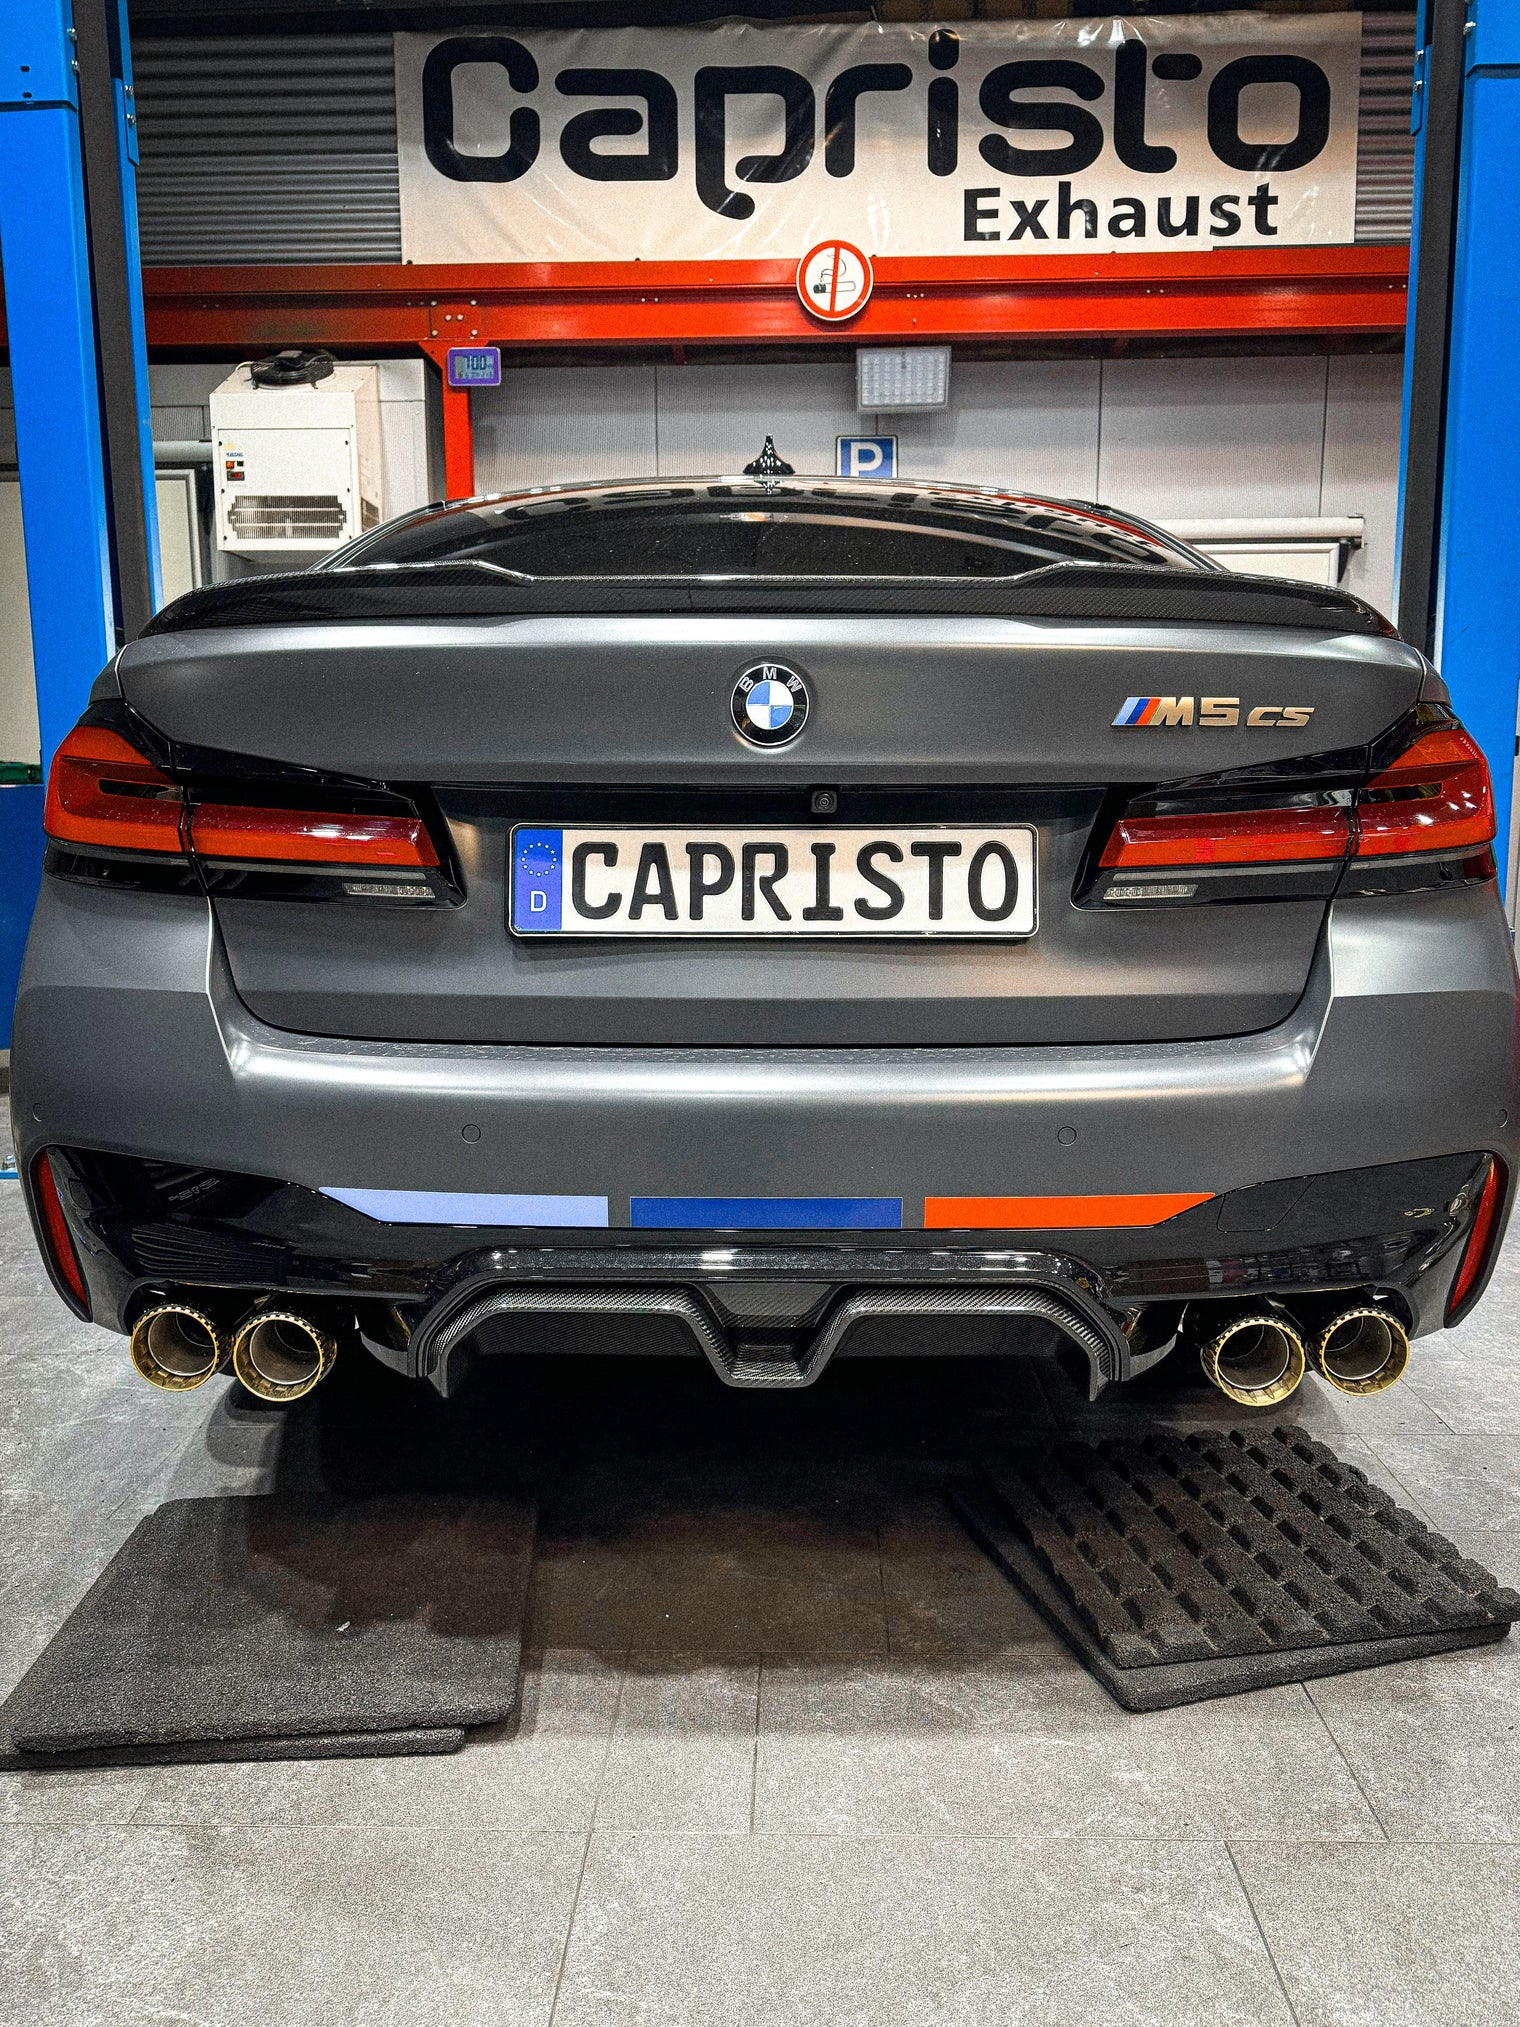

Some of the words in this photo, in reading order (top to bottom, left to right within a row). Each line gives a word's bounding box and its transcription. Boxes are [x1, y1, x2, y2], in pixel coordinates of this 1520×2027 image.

[422, 28, 1332, 221] Capristo
[963, 181, 1279, 242] Exhaust
[850, 442, 883, 477] P
[738, 665, 803, 693] BMW
[1149, 696, 1240, 727] M5
[1246, 706, 1316, 727] CS
[530, 890, 547, 912] D
[571, 840, 1019, 922] CAPRISTO
